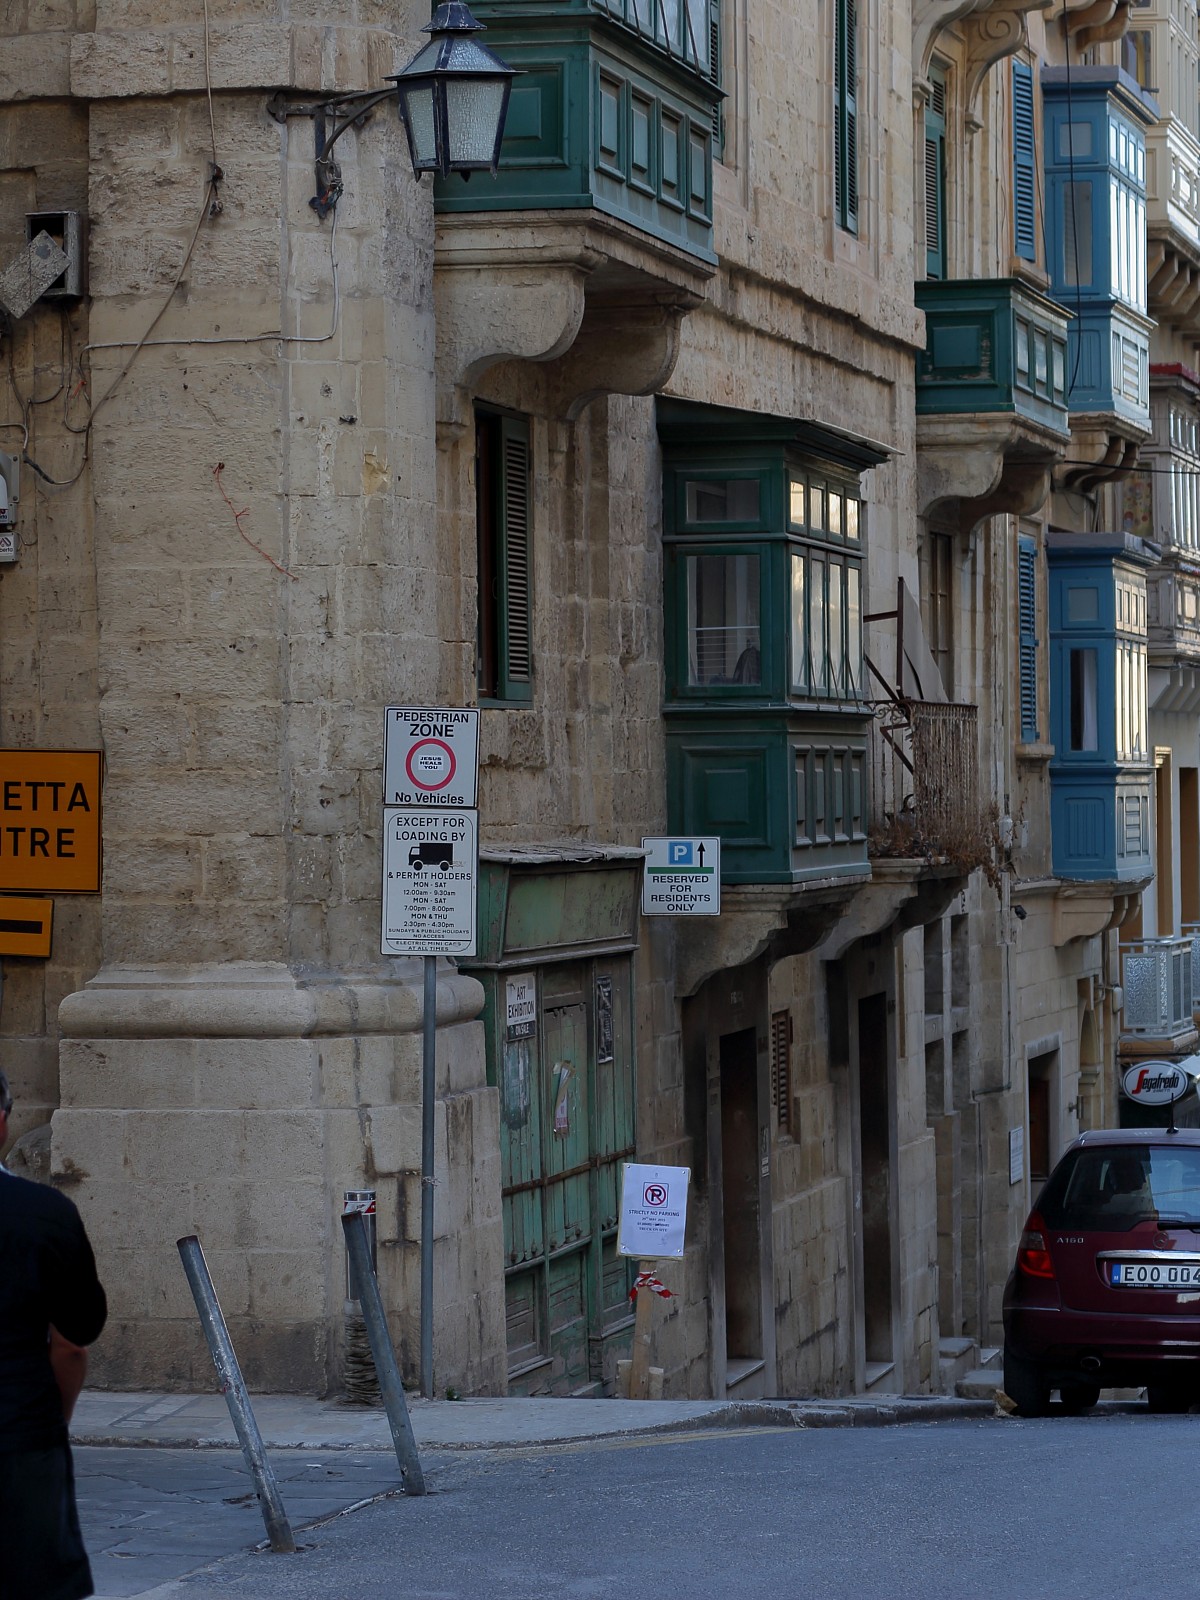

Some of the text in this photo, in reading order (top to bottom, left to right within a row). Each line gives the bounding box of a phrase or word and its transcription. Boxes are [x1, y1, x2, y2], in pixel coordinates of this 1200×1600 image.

[396, 711, 469, 723] PEDESTRIAN
[409, 724, 454, 737] ZONE
[3, 781, 91, 812] ETTA
[395, 792, 464, 804] No Vehicles
[396, 817, 465, 827] EXCEPT FOR
[0, 827, 76, 858] TRE
[396, 831, 466, 841] LOADING BY
[674, 845, 688, 861] P
[388, 871, 393, 879] &
[650, 894, 711, 902] RESIDENTS
[516, 986, 526, 1000] ART
[508, 1001, 535, 1018] EXHIBITION
[1131, 1069, 1180, 1095] Segafredo
